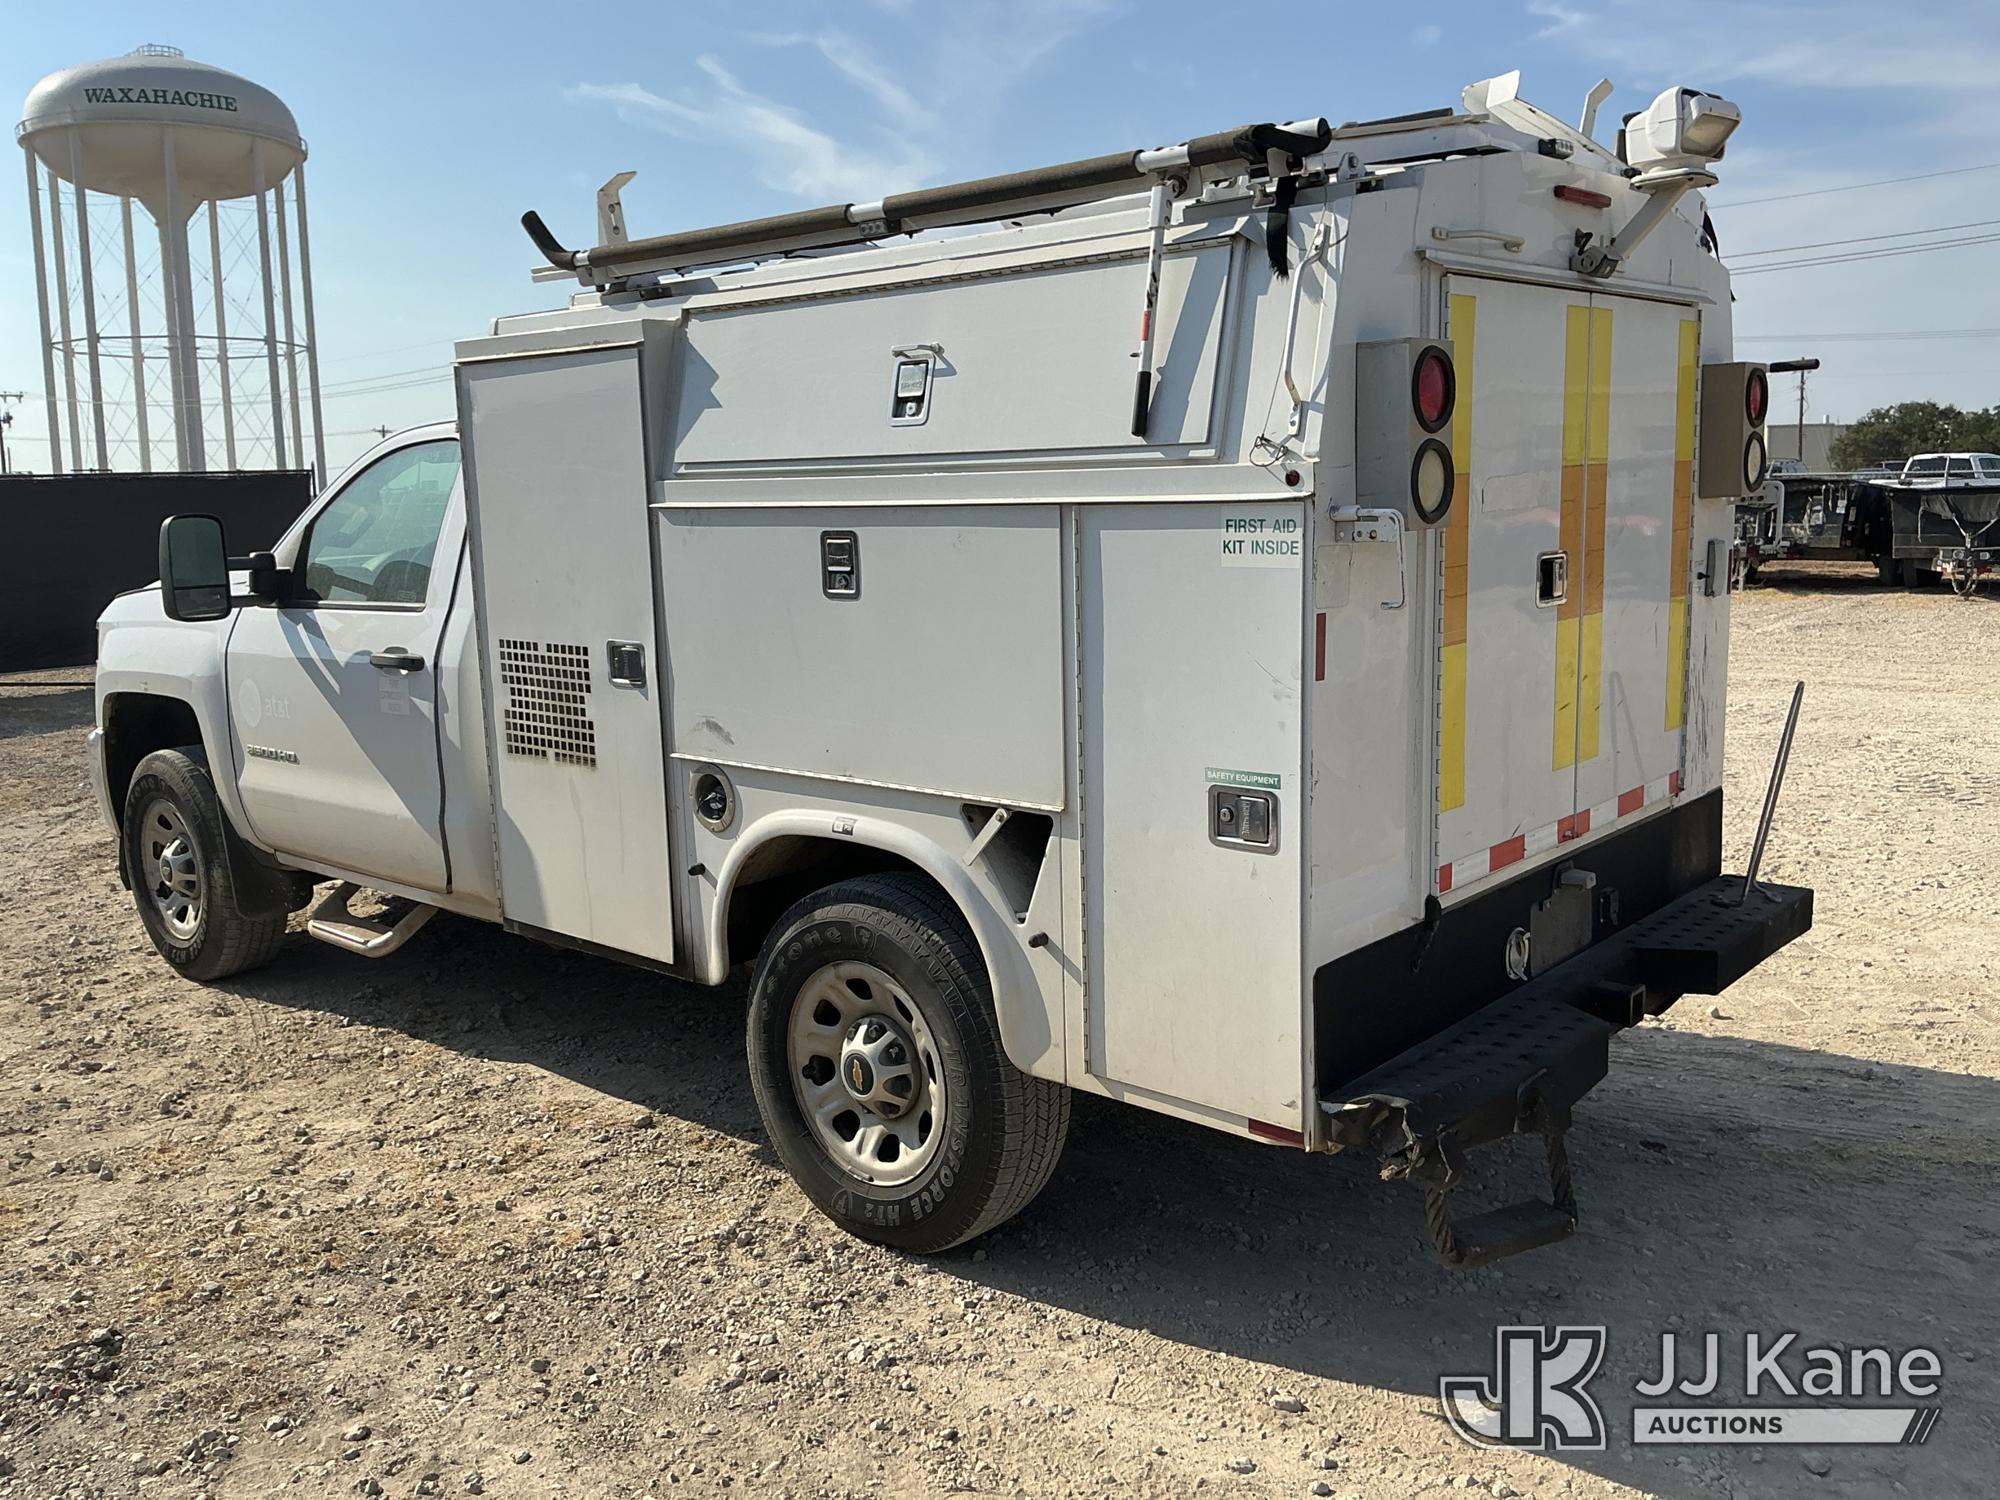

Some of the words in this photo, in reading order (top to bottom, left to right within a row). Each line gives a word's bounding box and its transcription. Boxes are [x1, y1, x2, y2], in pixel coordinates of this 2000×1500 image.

[84, 87, 238, 112] WAXAHACHIE
[1225, 518, 1266, 533] FIRST
[1272, 519, 1297, 533] AID
[1222, 540, 1245, 554] KIT
[1251, 540, 1299, 555] INSIDE
[1207, 770, 1234, 780] SAFETY
[1236, 774, 1278, 784] EQUIPMENT
[909, 1049, 970, 1222] TRANSFORCE
[863, 1202, 902, 1228] HT2
